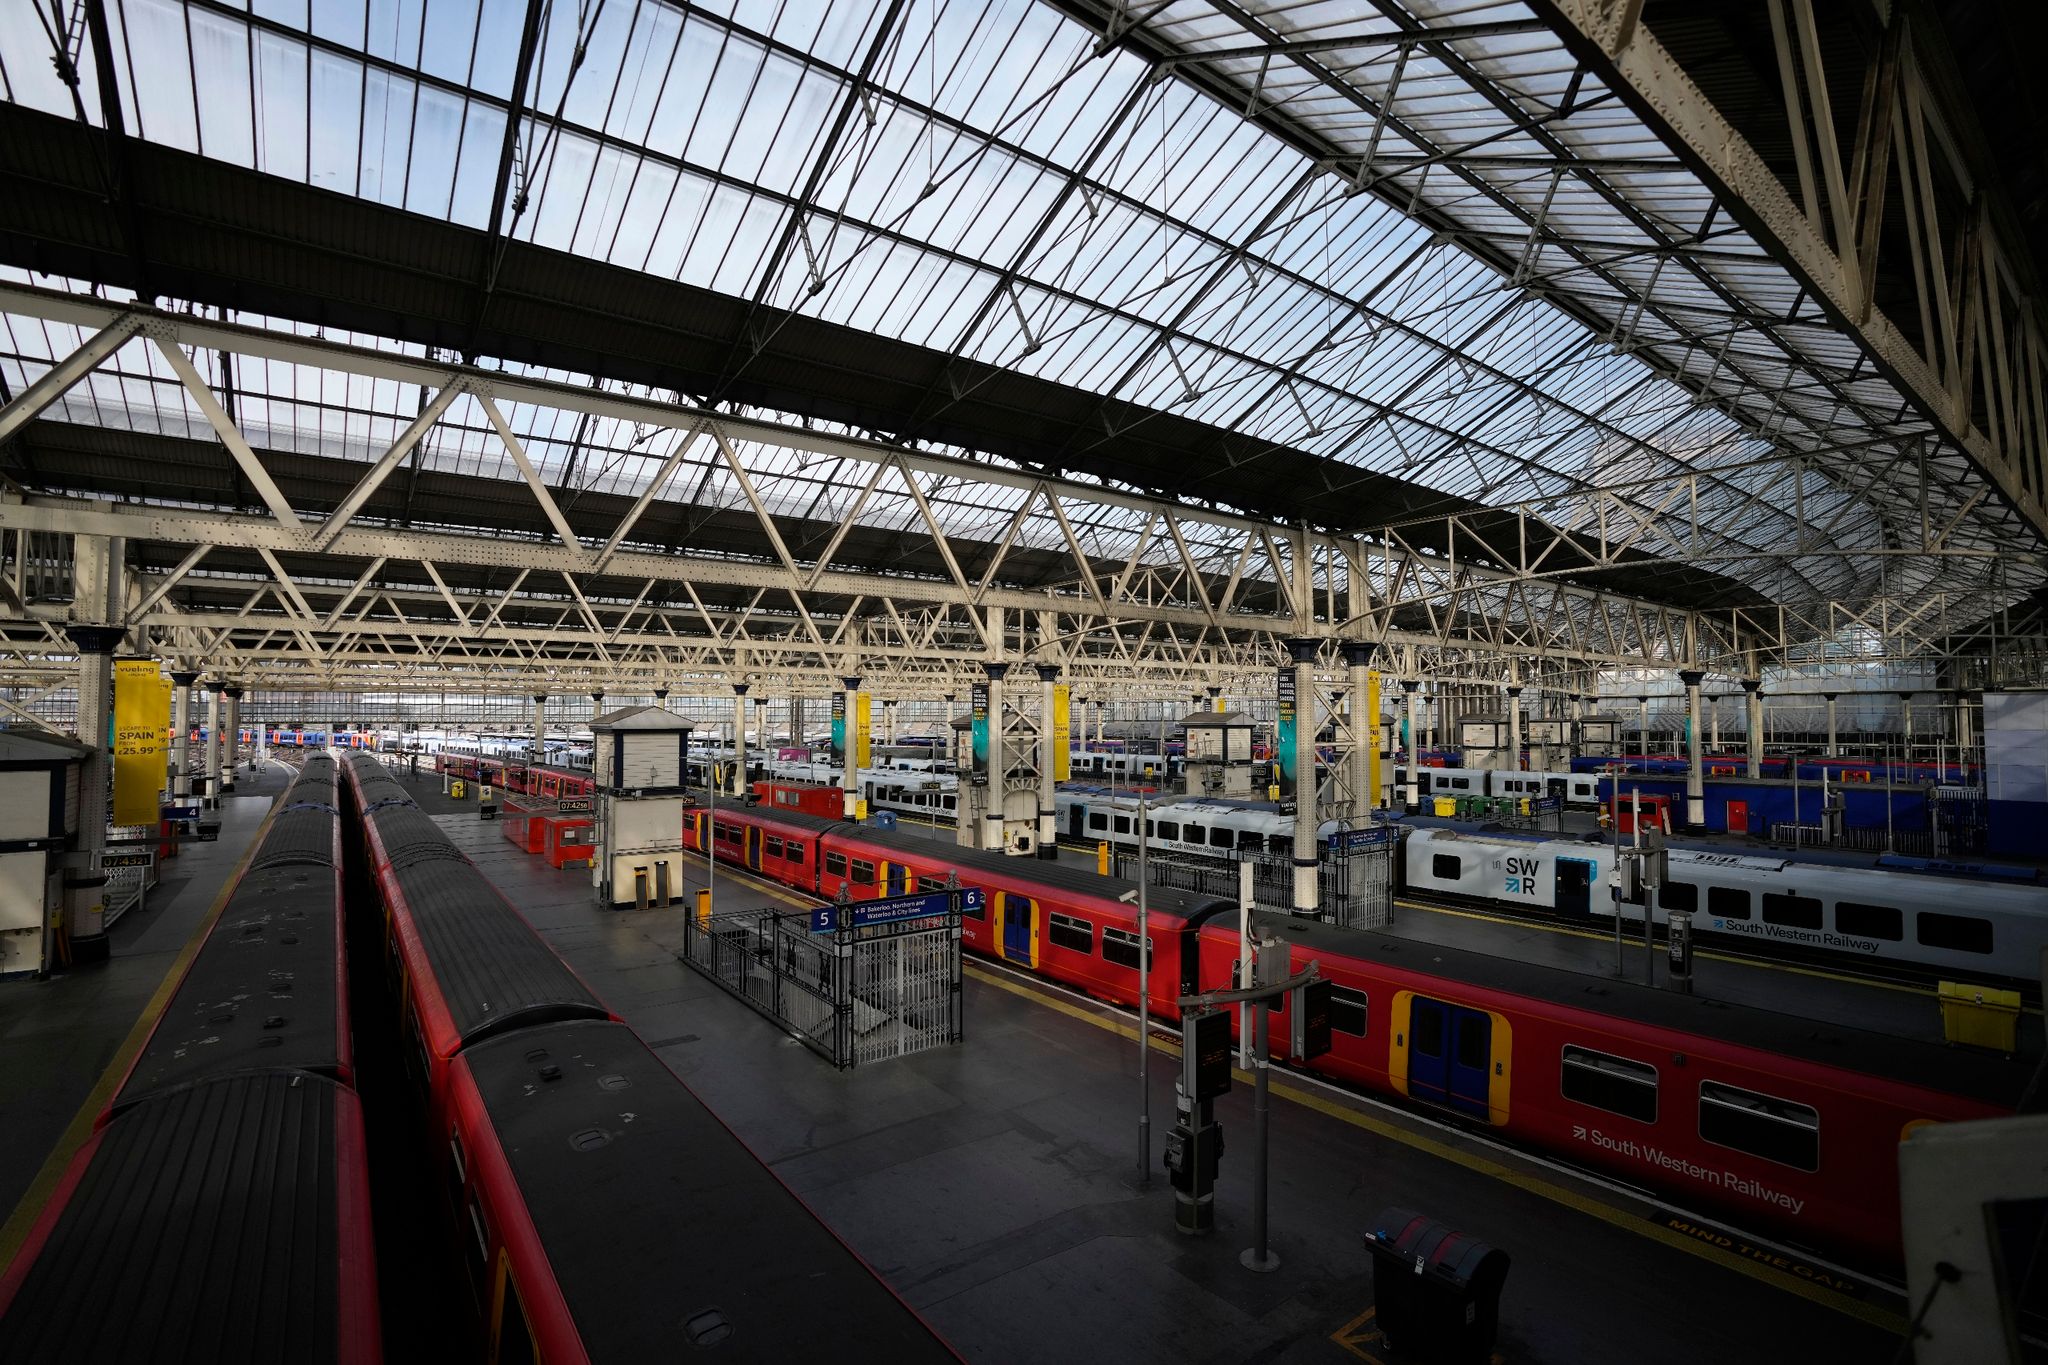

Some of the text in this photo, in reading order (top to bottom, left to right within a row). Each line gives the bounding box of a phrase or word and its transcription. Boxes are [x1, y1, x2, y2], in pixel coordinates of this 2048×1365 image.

[119, 666, 155, 674] vueling
[119, 732, 154, 740] SPAIN
[188, 808, 197, 816] 4
[1169, 841, 1184, 850] South
[1205, 846, 1225, 857] Railway
[1506, 857, 1540, 877] SW
[1522, 877, 1536, 896] R
[967, 891, 976, 905] 6
[867, 904, 892, 913] Bakerloo,
[892, 901, 916, 910] Northern
[867, 911, 892, 919] Waterloo
[908, 906, 921, 914] lines
[820, 912, 829, 926] 5
[1726, 919, 1880, 953] South Western Railway
[1591, 1130, 1804, 1215] South Western Railway
[1667, 1218, 1856, 1291] MIND THE GAP
